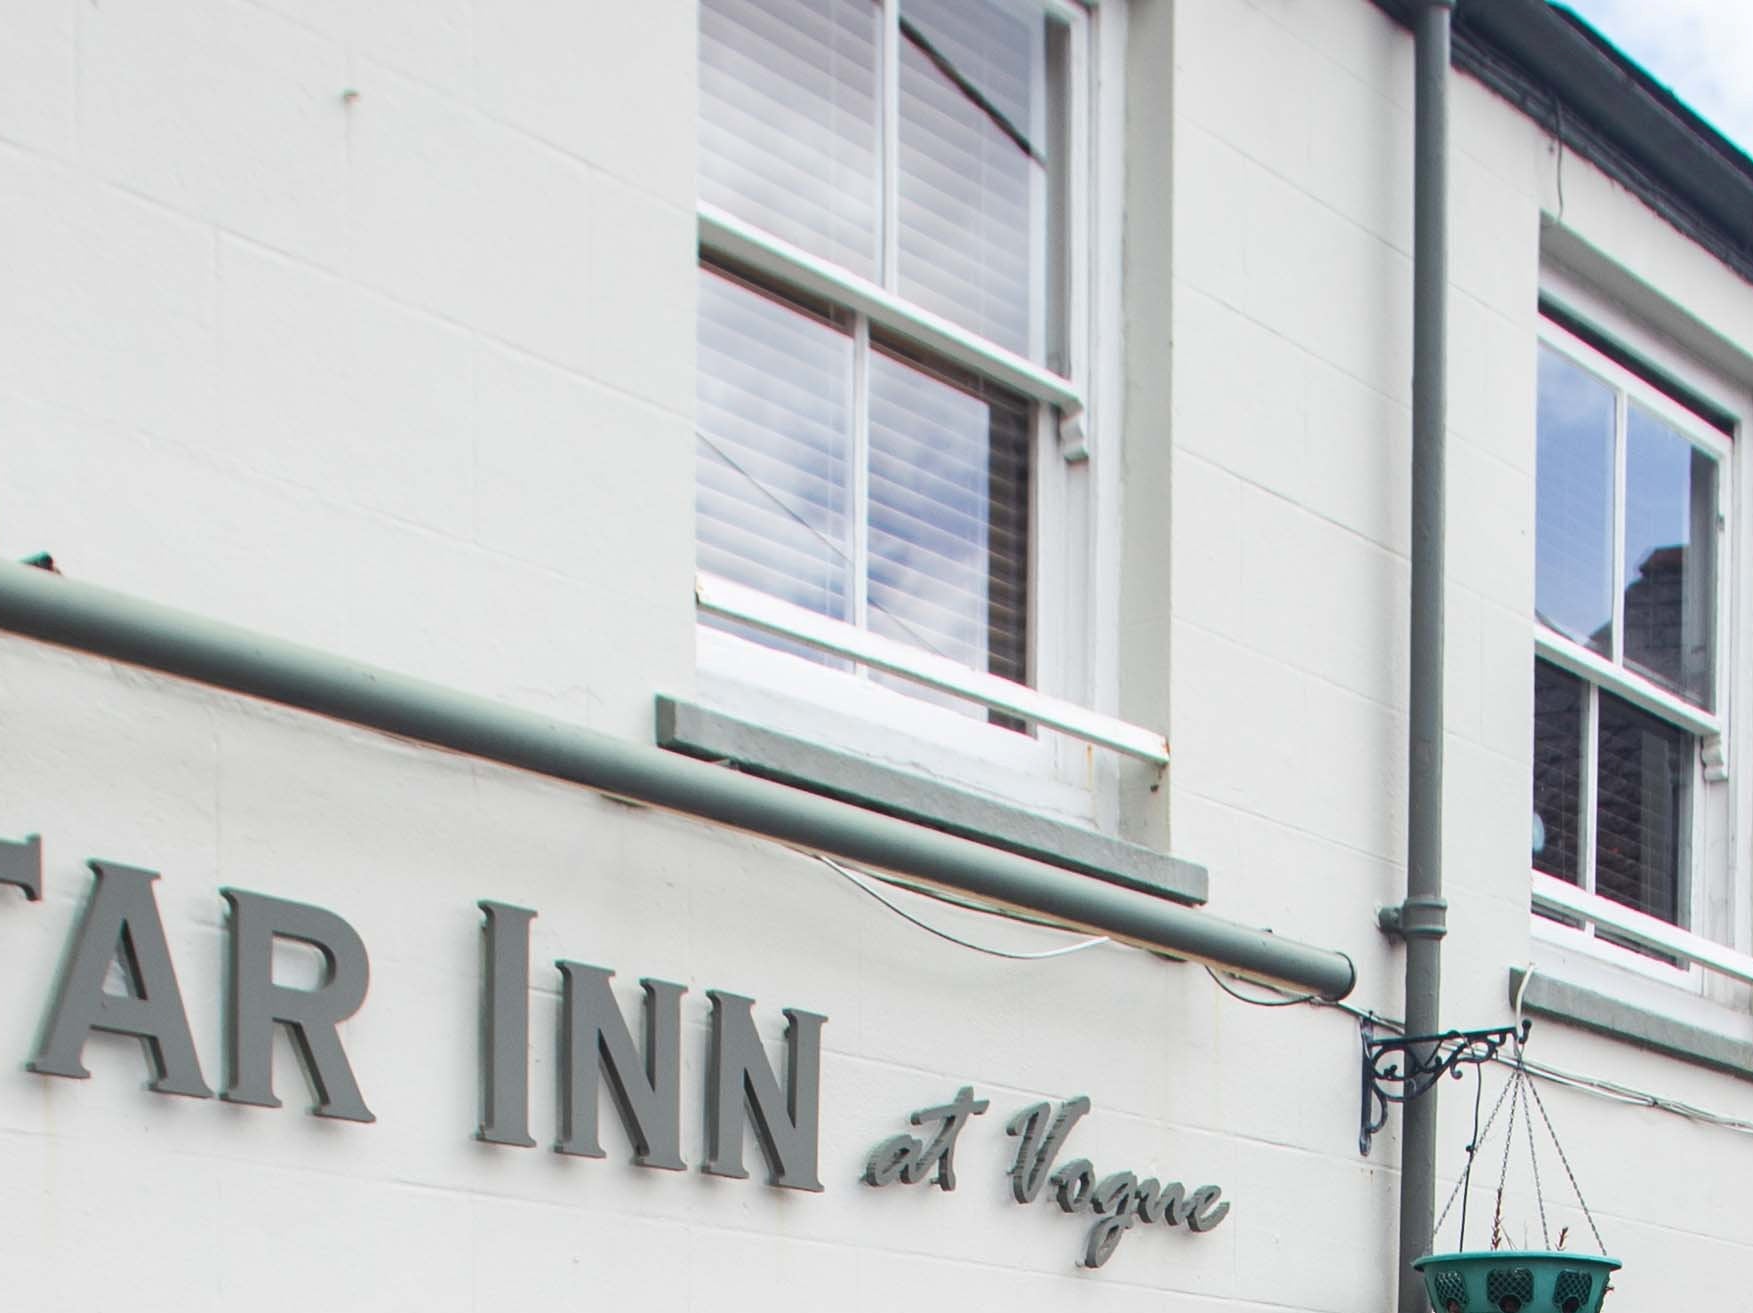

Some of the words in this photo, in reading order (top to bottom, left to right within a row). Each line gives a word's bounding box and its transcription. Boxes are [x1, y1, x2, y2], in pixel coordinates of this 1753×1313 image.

[477, 900, 828, 1192] INN
[858, 1085, 989, 1191] at
[1004, 1095, 1230, 1269] Vogue
